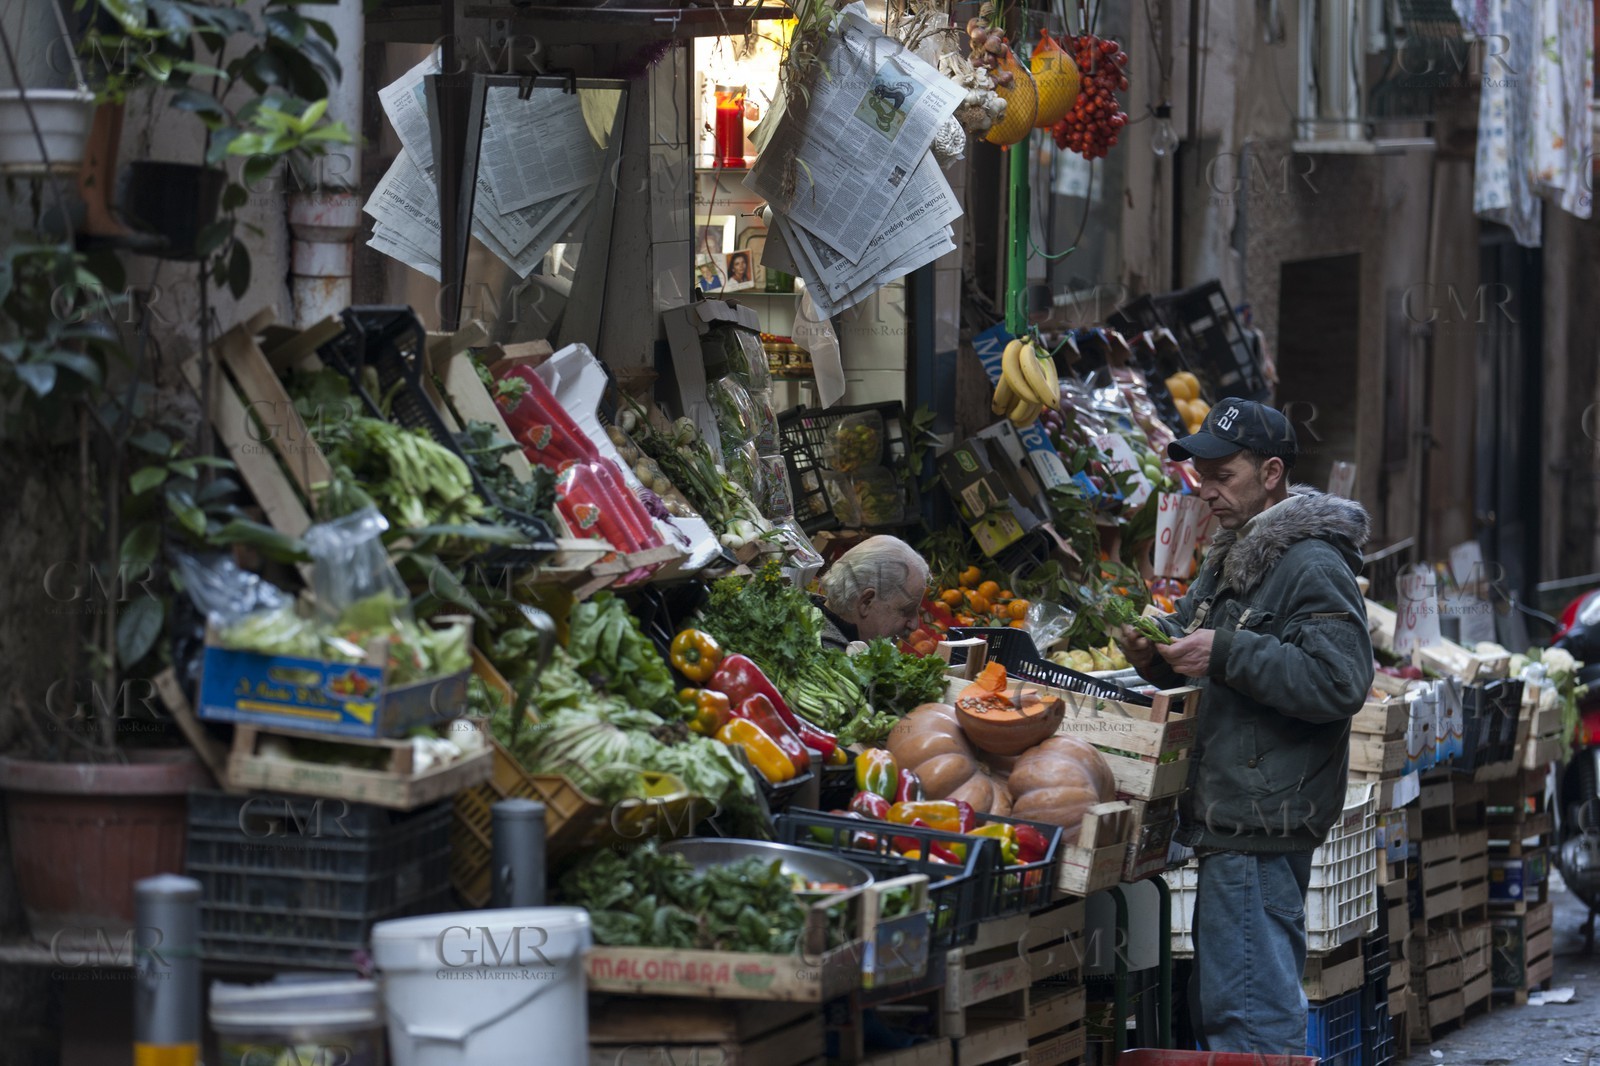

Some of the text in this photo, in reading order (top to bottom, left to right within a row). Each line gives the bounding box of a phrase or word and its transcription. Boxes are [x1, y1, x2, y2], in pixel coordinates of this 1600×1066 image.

[924, 192, 946, 209] Incubo
[884, 219, 905, 237] doppia
[591, 957, 731, 983] MALOMBRA
